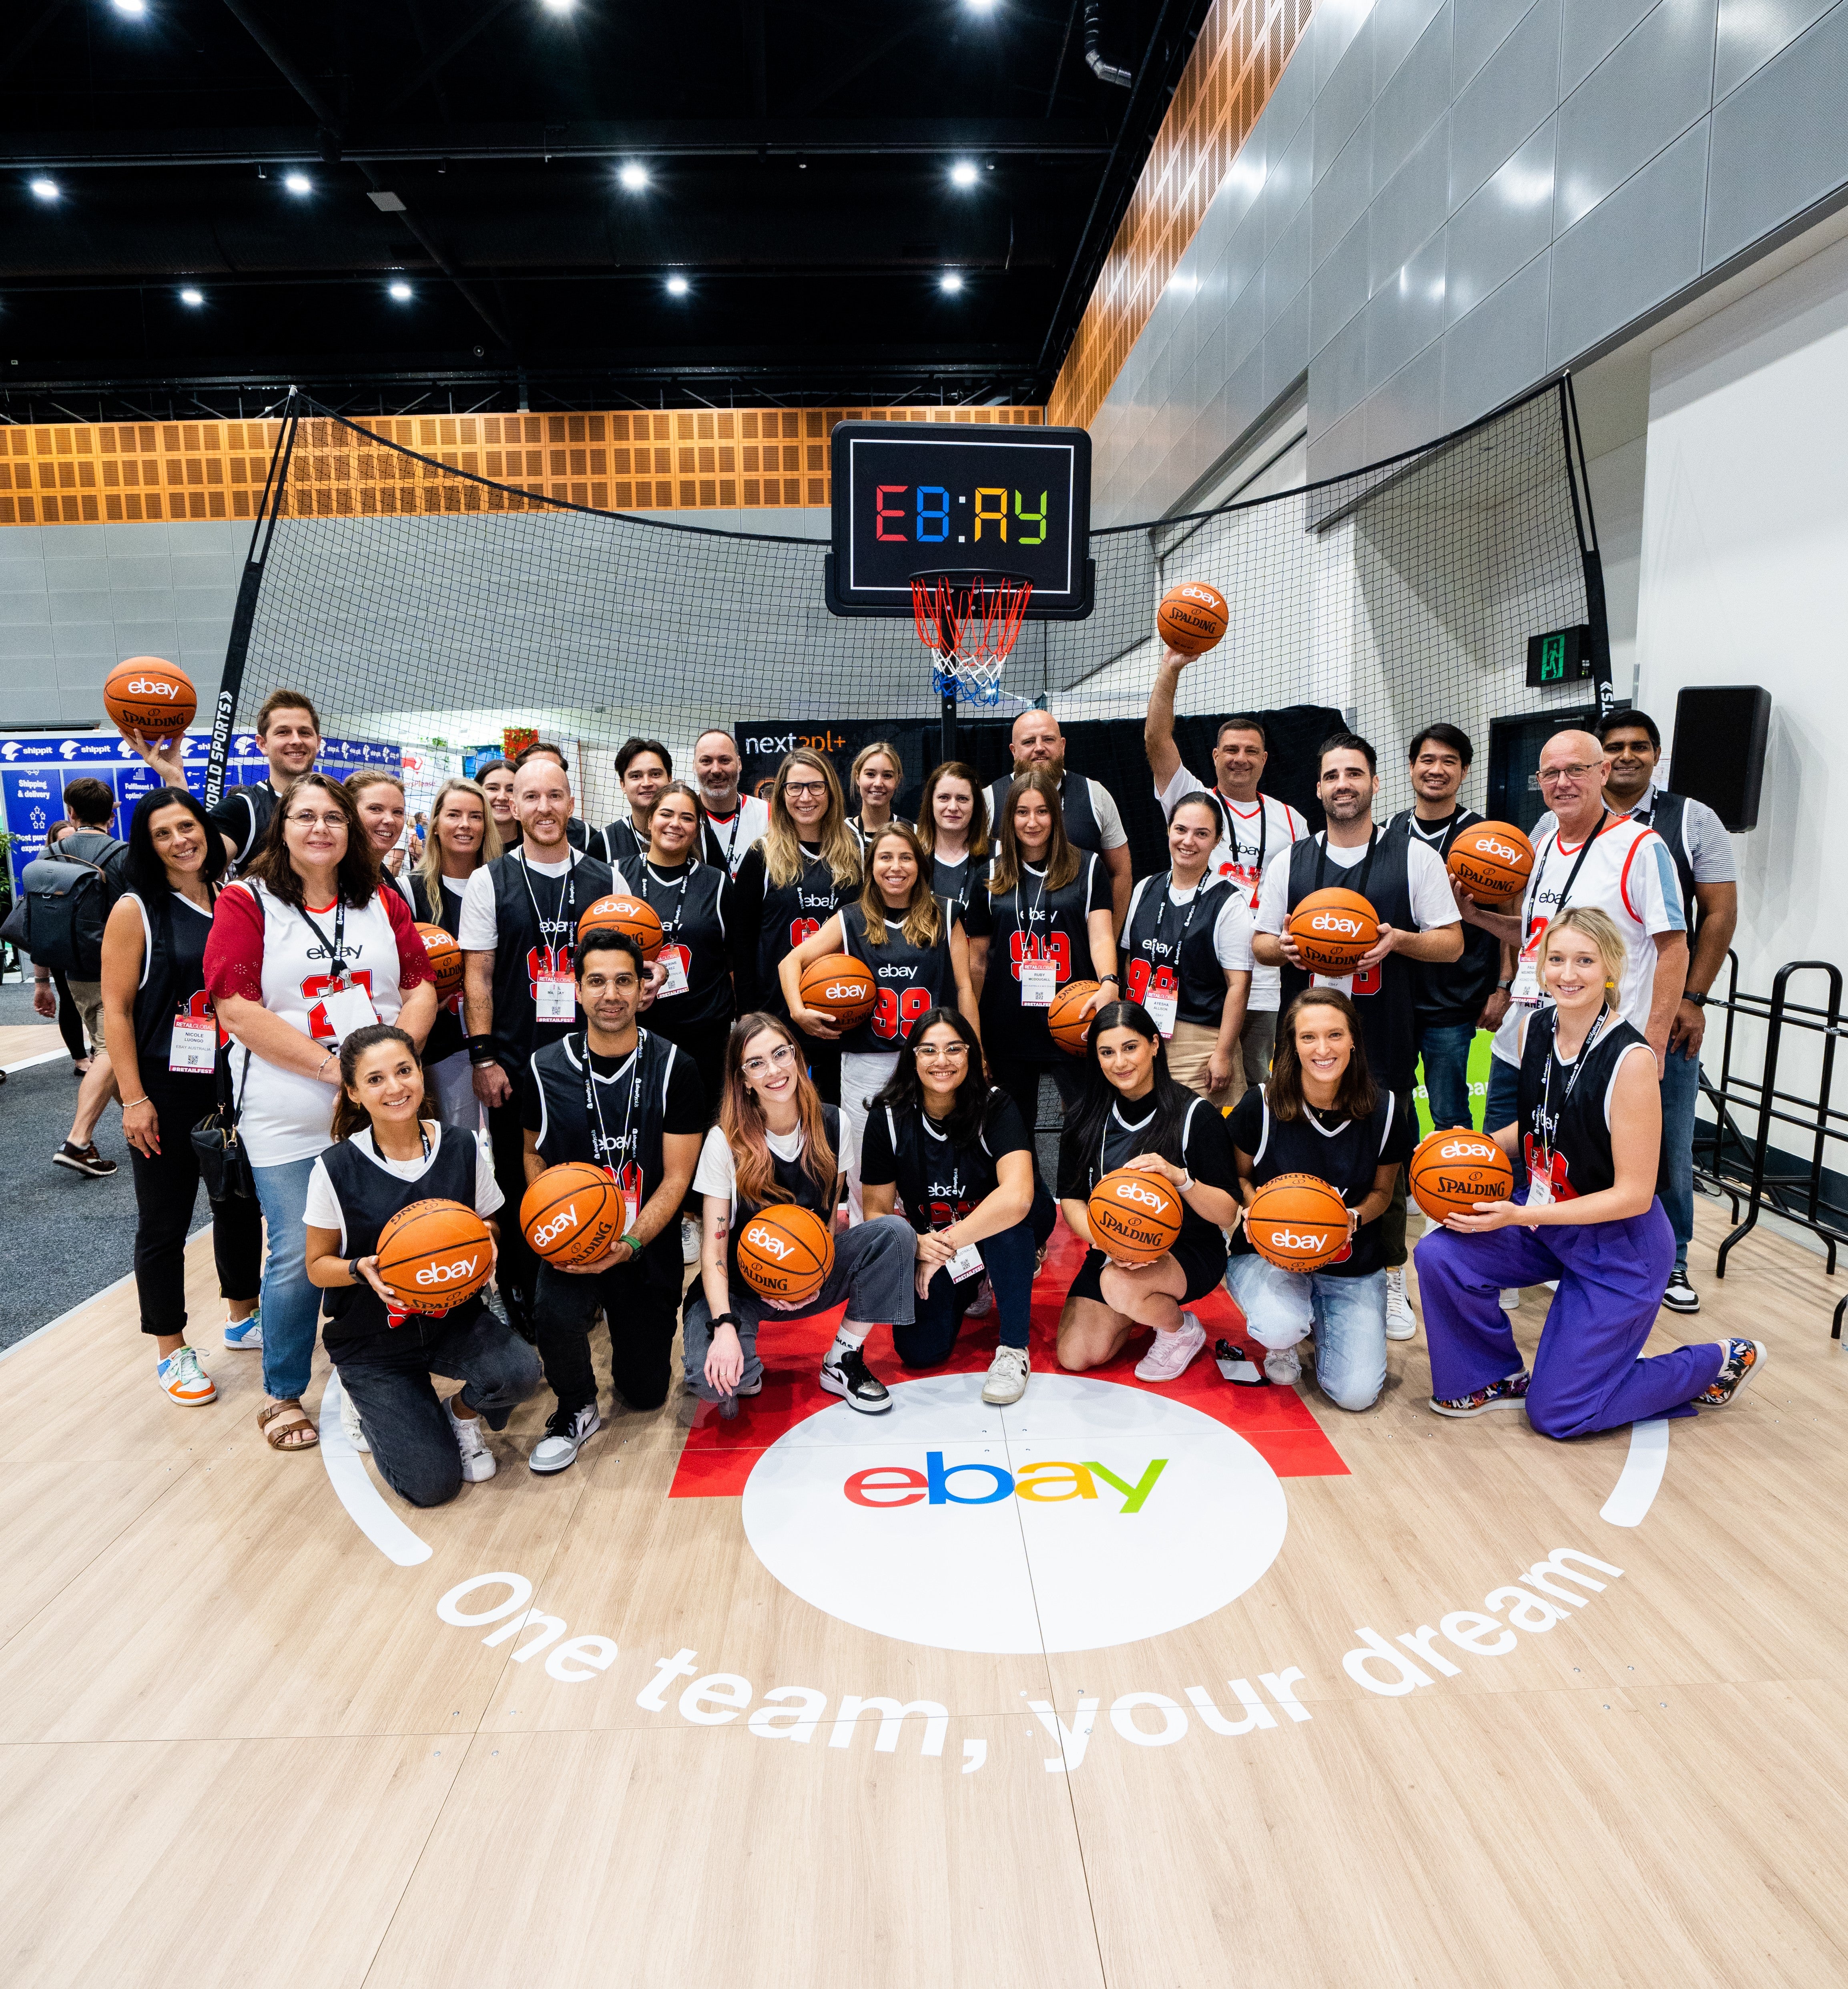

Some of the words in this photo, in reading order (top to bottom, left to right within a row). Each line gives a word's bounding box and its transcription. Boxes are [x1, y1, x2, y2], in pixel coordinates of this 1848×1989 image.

[877, 485, 1047, 544] EB:AY
[1182, 587, 1220, 608] ebay
[1169, 607, 1217, 634] SPALDING
[128, 678, 179, 699] ebay
[122, 710, 183, 726] SPALDING
[211, 701, 231, 762] SPORTS
[23, 747, 52, 755] shippit
[81, 745, 111, 754] shippit
[19, 780, 47, 790] Shipping
[24, 790, 50, 800] delivery
[32, 834, 48, 842] purc
[21, 845, 44, 853] experie
[1476, 838, 1523, 865] ebay
[1458, 863, 1515, 892] SPALDING
[593, 901, 640, 917] ebay
[1312, 913, 1363, 938] ebay
[307, 945, 363, 960] ebay
[656, 954, 678, 962] AILGLOBAL
[878, 964, 918, 979] ebay
[659, 988, 688, 997] #RETAILFEST
[826, 982, 867, 999] ebay
[871, 987, 931, 1040] 99
[176, 1022, 213, 1030] RETAILGLOBAL
[1441, 1141, 1496, 1162] ebay
[1438, 1177, 1505, 1197] SPALDING
[1116, 1183, 1169, 1214] ebay
[534, 1203, 578, 1247] ebay
[1100, 1211, 1164, 1246] SPALDING
[747, 1227, 795, 1261] ebay
[1271, 1229, 1327, 1252] ebay
[416, 1255, 478, 1285] ebay
[955, 1266, 983, 1282] #RETAILFEST
[843, 1451, 1170, 1514] ebay
[435, 1571, 619, 1682] One
[635, 1647, 988, 1774] team,
[1027, 1665, 1313, 1772] your
[1341, 1547, 1625, 1697] dream
